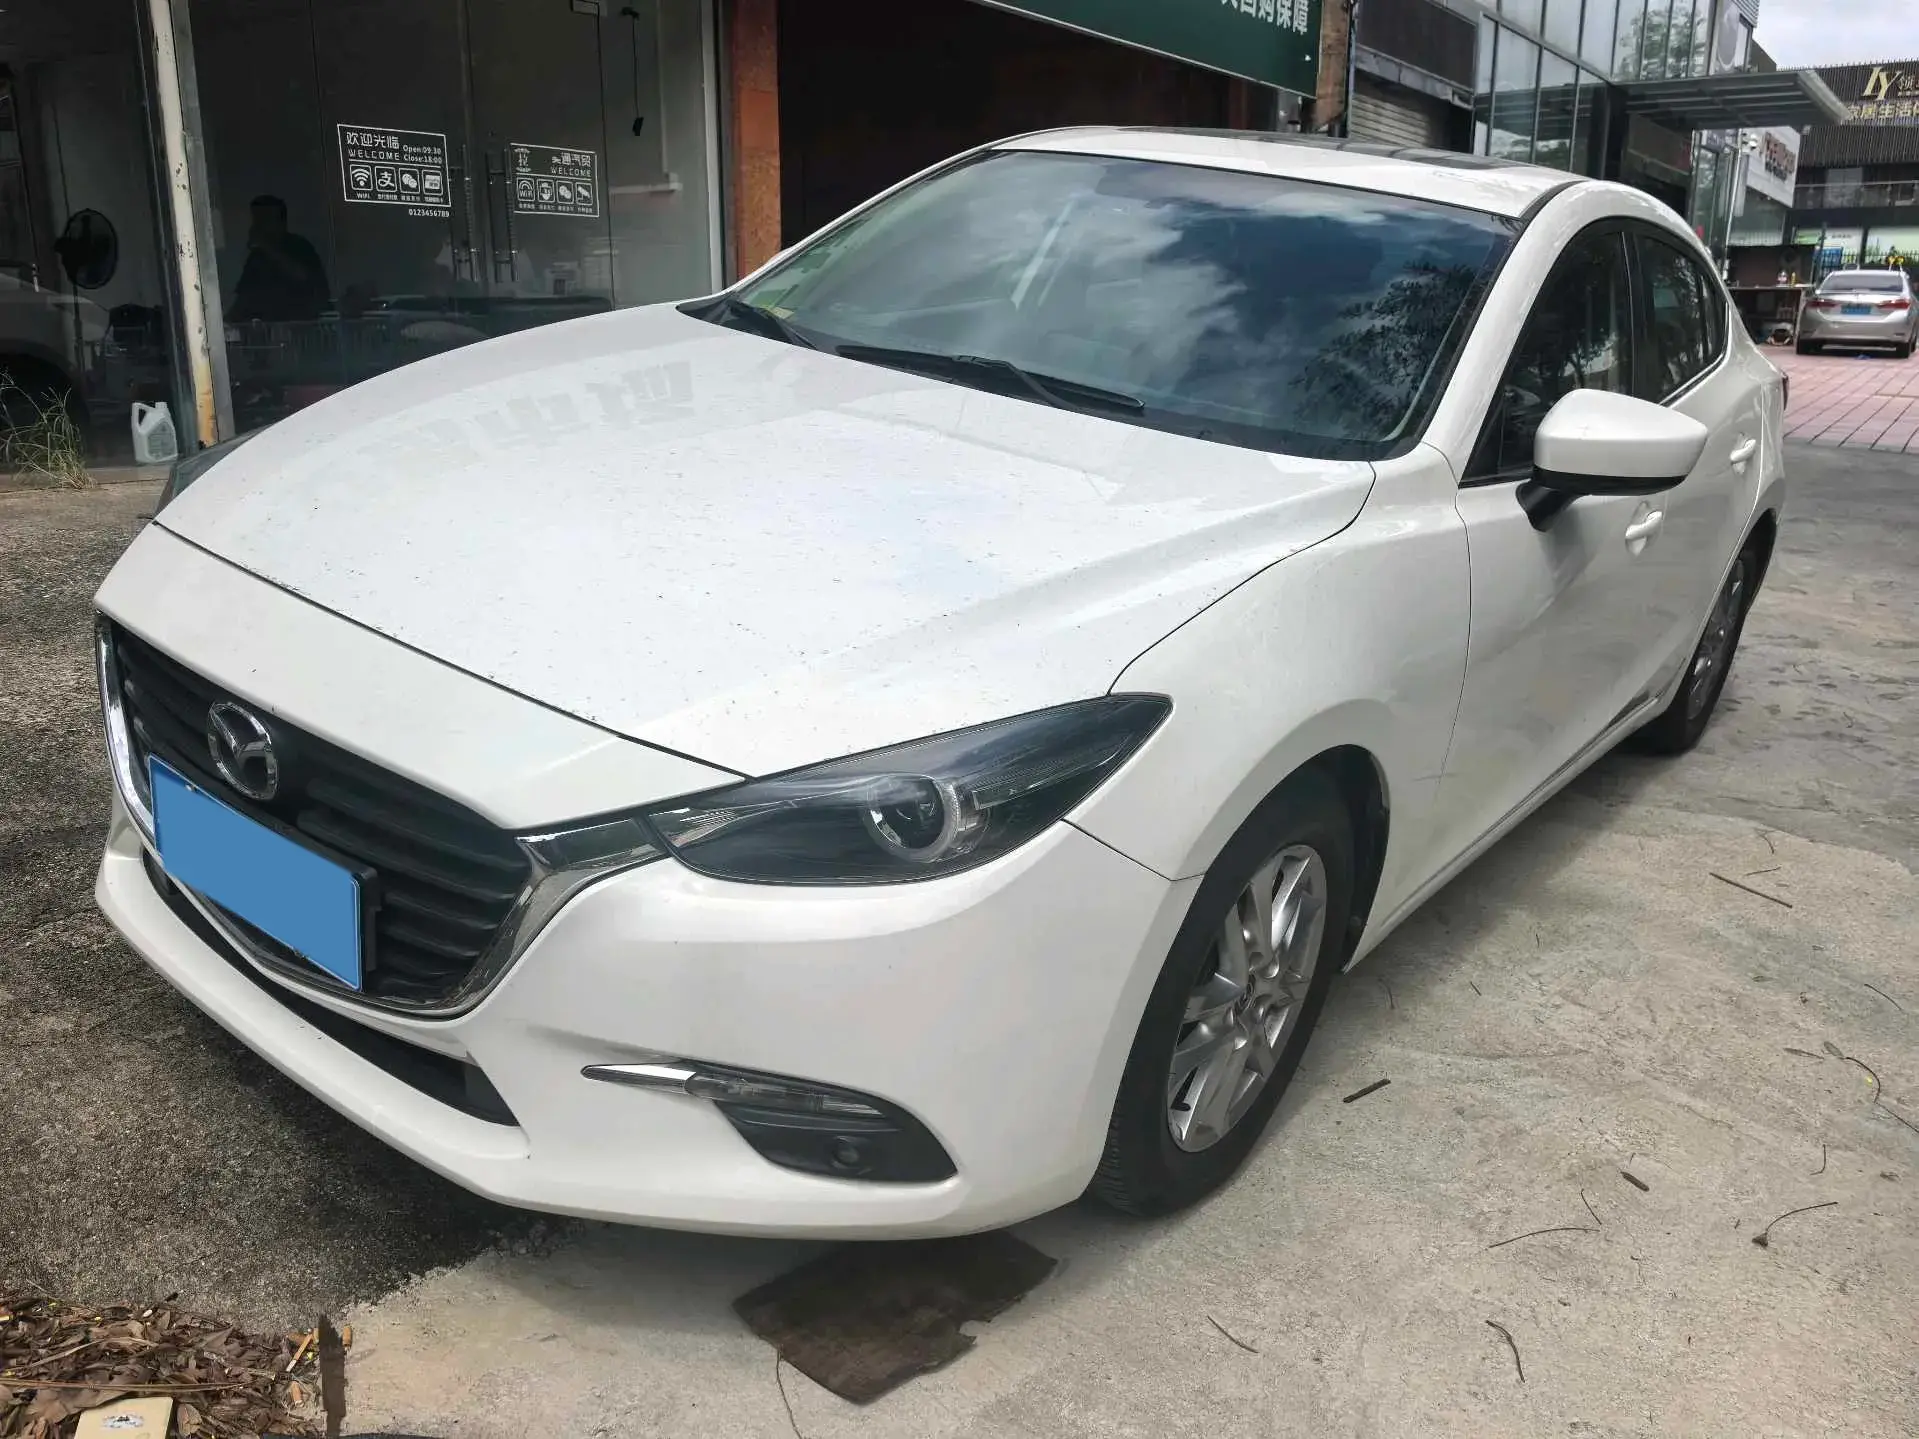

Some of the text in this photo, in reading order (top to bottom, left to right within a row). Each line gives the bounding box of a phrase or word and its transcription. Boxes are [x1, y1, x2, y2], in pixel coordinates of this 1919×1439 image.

[346, 131, 400, 149] 欢迎光临
[348, 149, 400, 160] WELCOME
[551, 166, 592, 177] WELCOME
[408, 208, 450, 218] 0123456789
